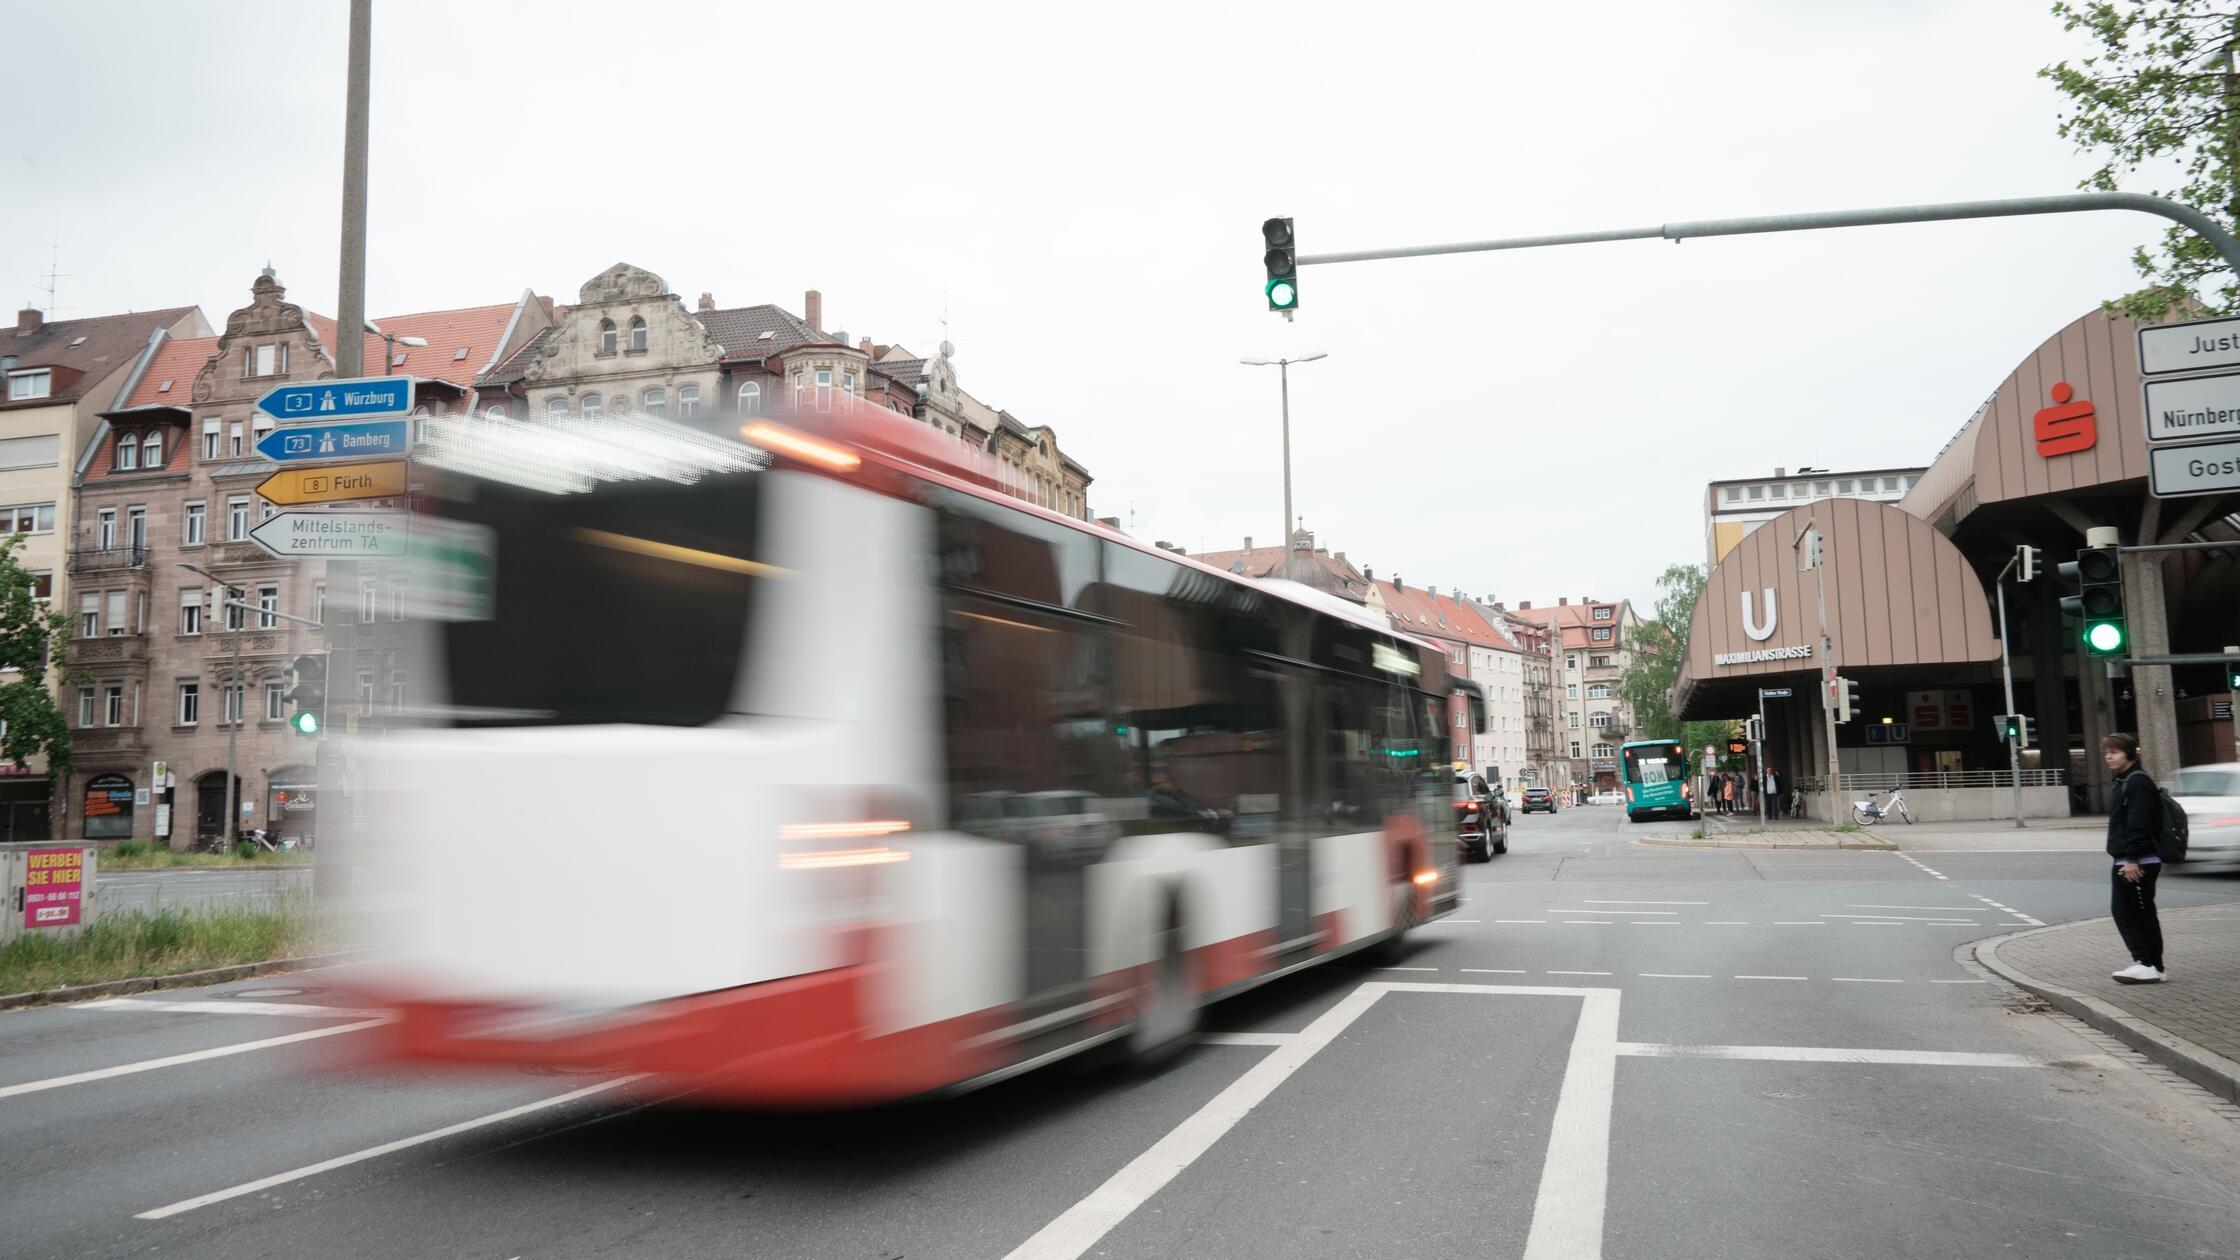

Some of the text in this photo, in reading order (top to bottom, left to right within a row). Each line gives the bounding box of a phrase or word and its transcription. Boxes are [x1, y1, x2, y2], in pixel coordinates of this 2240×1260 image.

[295, 391, 395, 408] 3 Würzburg
[291, 432, 391, 450] 73 Bamberg
[312, 474, 373, 491] 8 Fürth
[292, 519, 392, 534] Mittelstands-
[291, 535, 379, 549] zentrum TA
[1741, 588, 1777, 641] U
[1714, 645, 1812, 666] MAXIMILIANSTRASSE
[29, 853, 81, 869] WERBEN
[28, 869, 81, 886] SIE HIER
